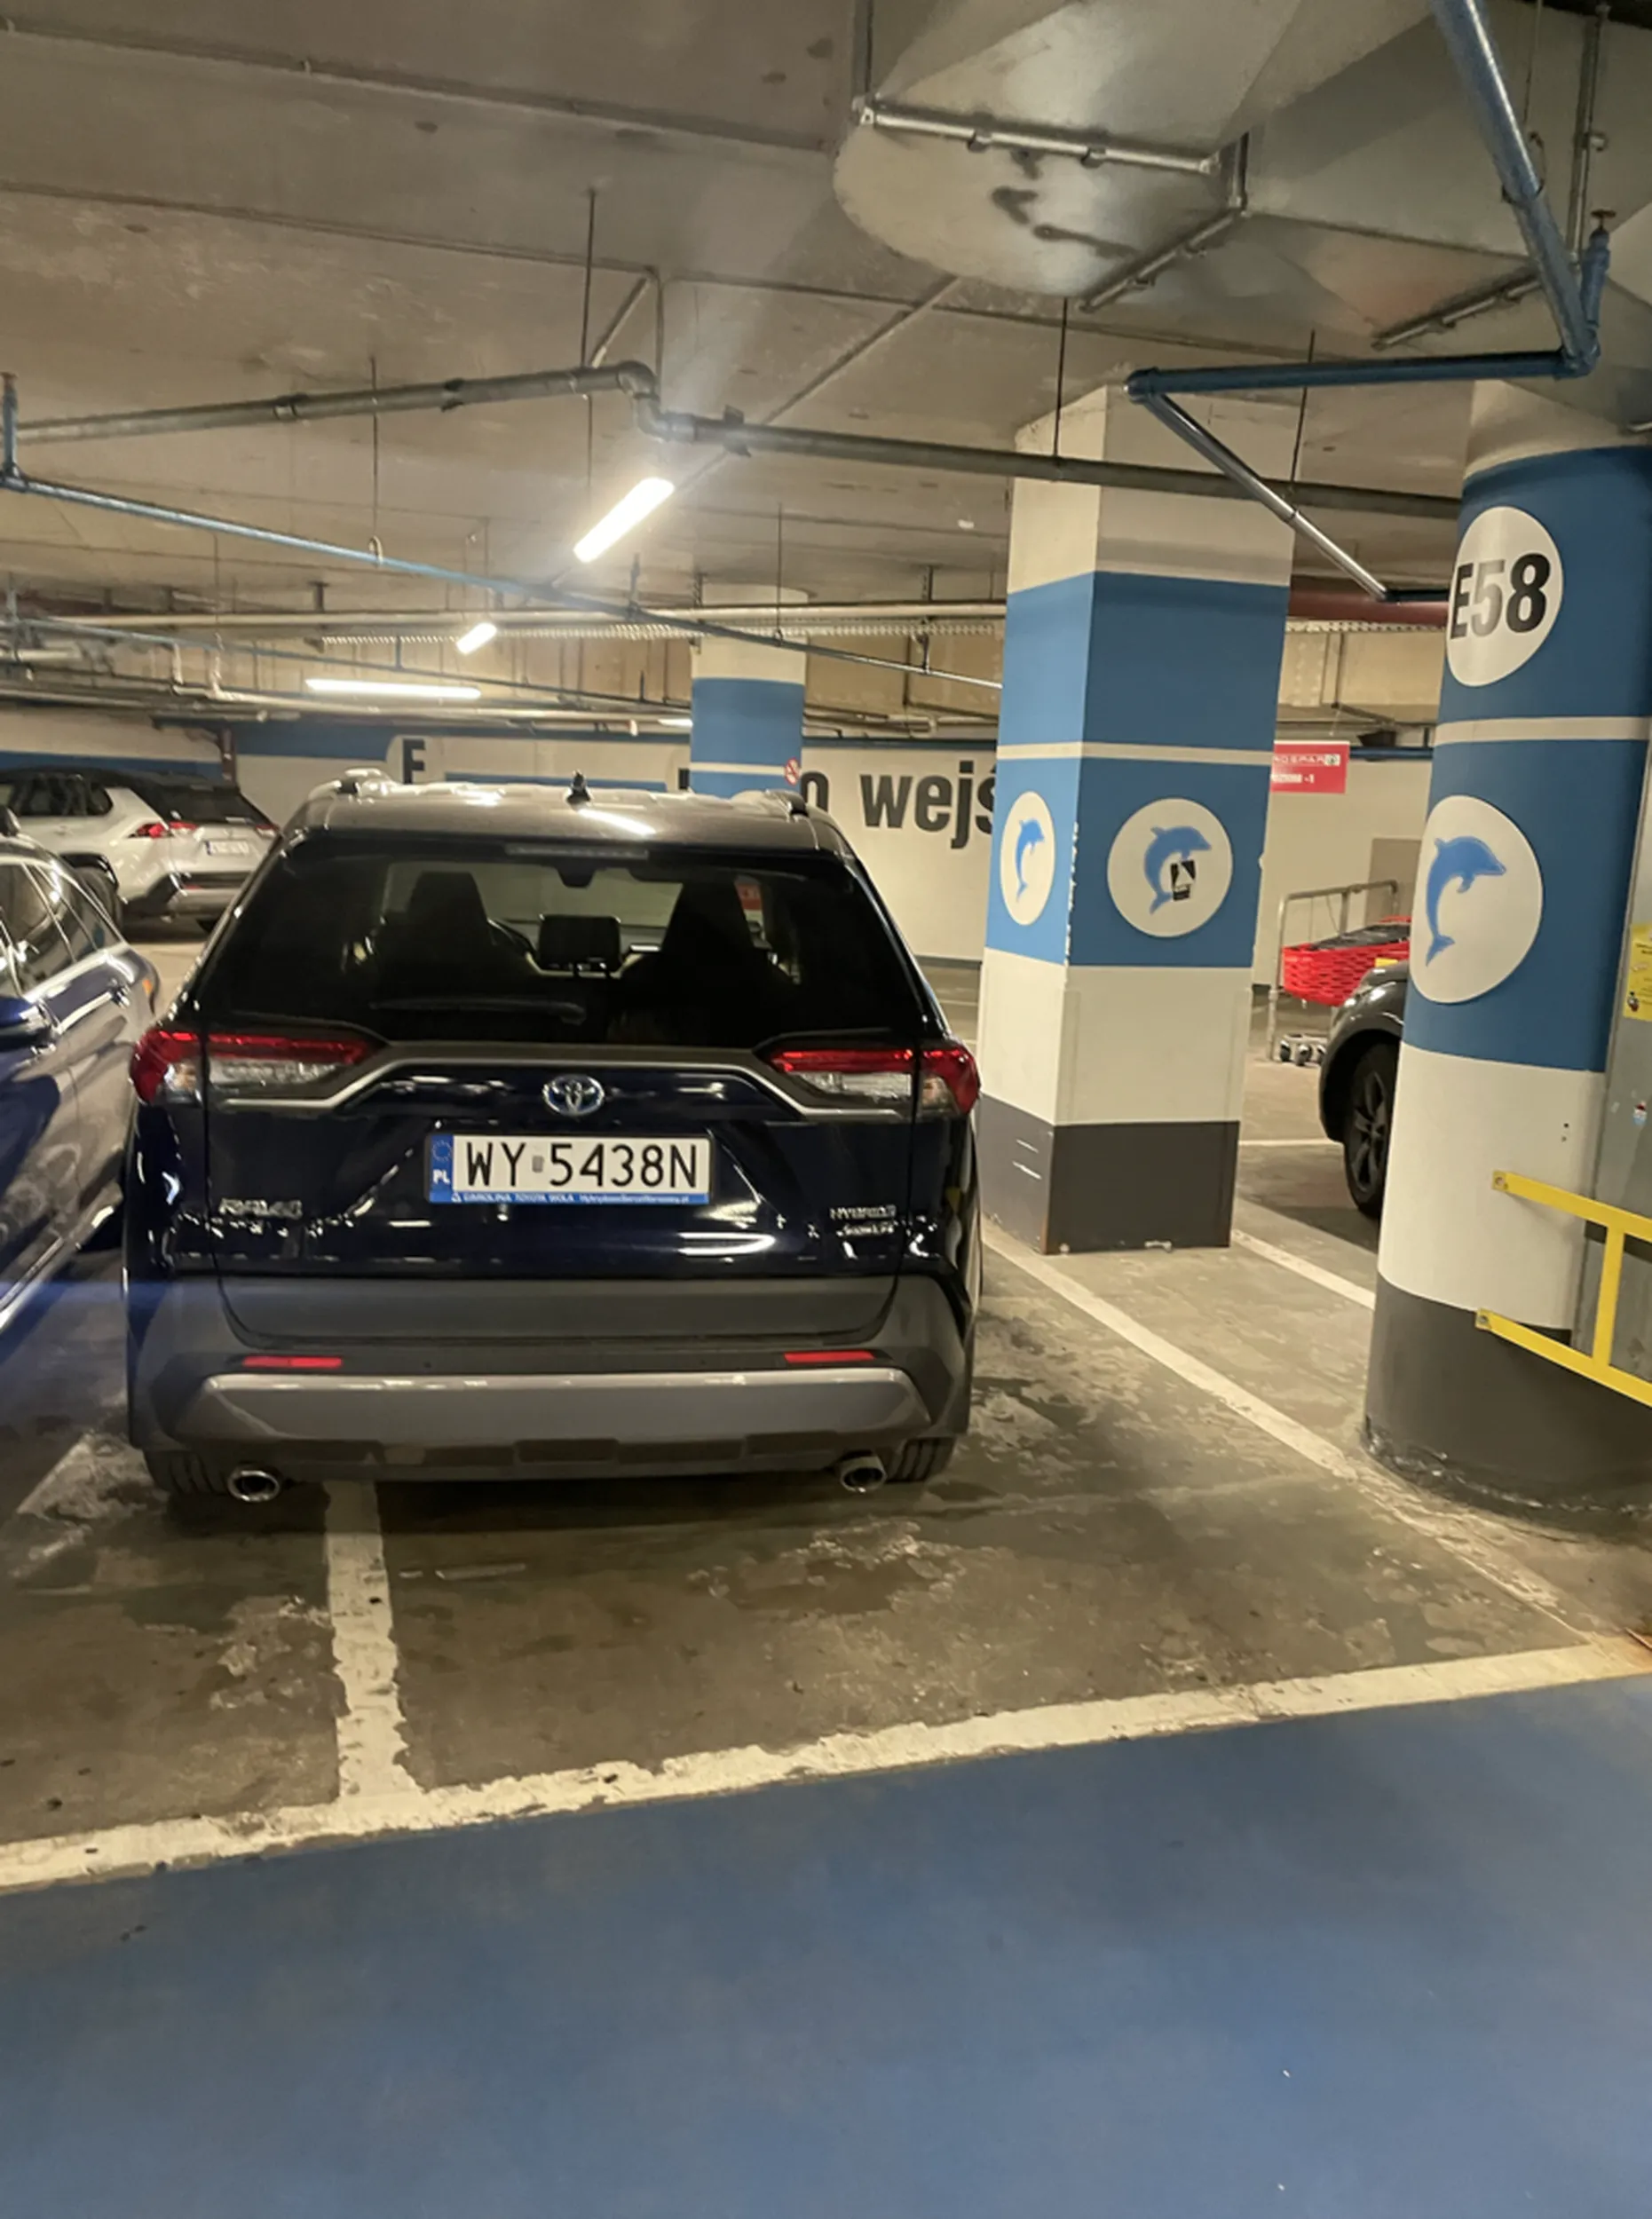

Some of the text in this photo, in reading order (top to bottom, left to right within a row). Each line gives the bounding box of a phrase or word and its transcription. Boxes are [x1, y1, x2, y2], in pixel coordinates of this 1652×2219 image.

[1450, 553, 1551, 639] E58
[403, 738, 425, 785] F
[432, 1168, 451, 1185] PL
[466, 1141, 697, 1188] WY 5438N
